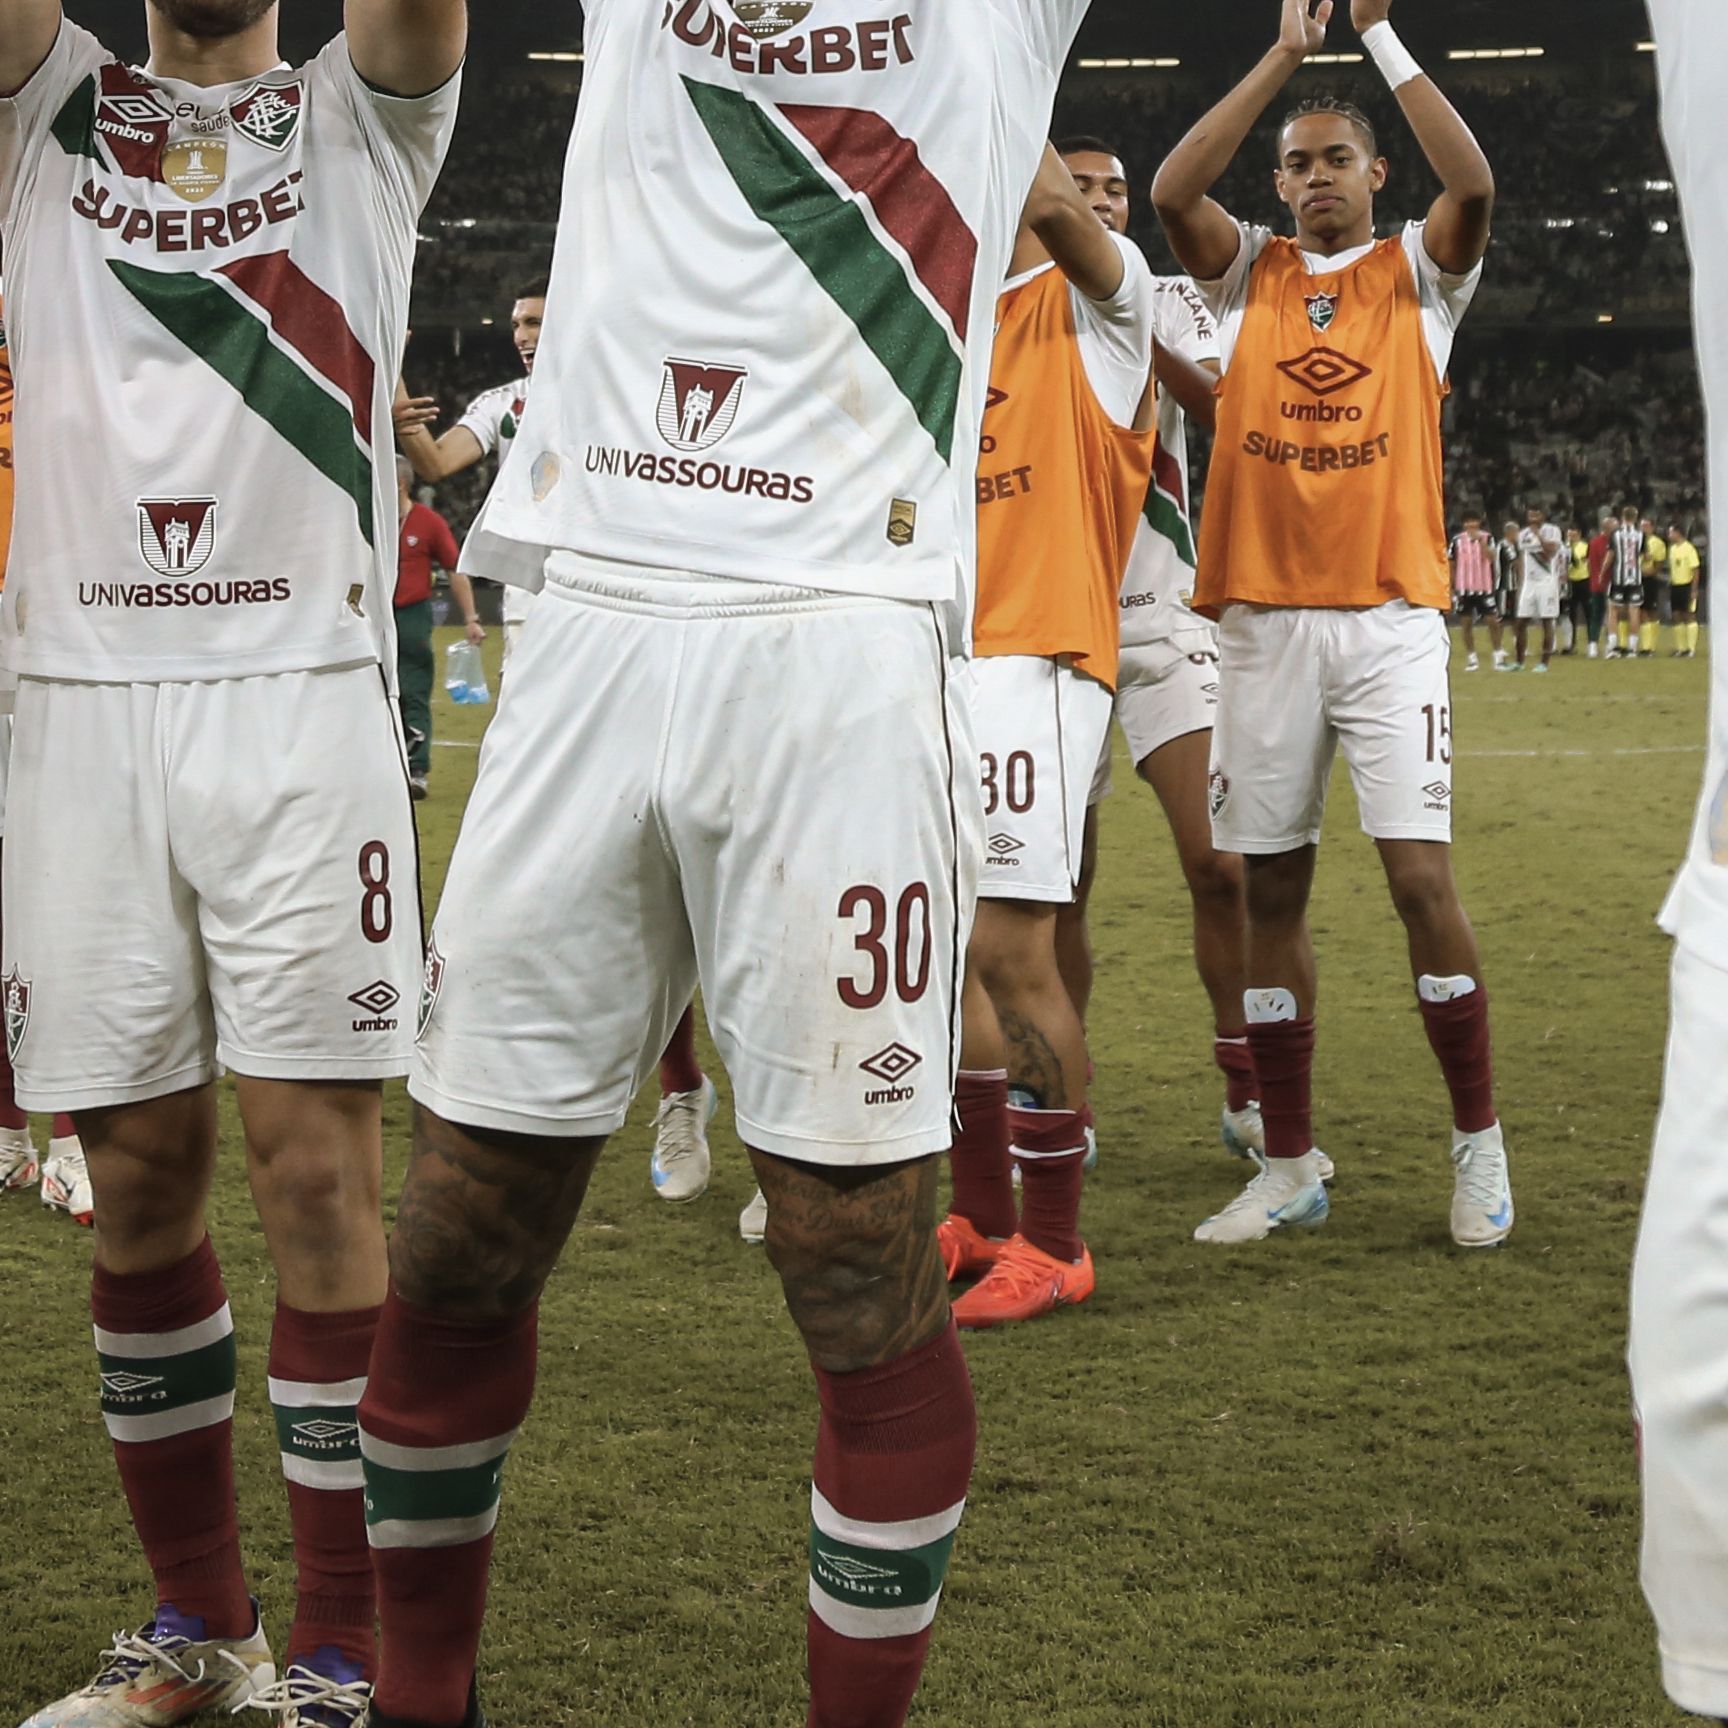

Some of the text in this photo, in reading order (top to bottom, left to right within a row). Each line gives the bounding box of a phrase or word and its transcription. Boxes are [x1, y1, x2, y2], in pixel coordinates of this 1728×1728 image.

[94, 117, 155, 144] umbro
[1155, 281, 1213, 341] ZINZANE
[1281, 400, 1362, 422] umbro
[1242, 430, 1390, 472] SUPERBET
[1421, 703, 1451, 765] 15
[980, 750, 1035, 816] 30
[358, 839, 393, 944] 8
[836, 881, 932, 1010] 30
[351, 1014, 398, 1033] umbro
[864, 1085, 915, 1106] umbro
